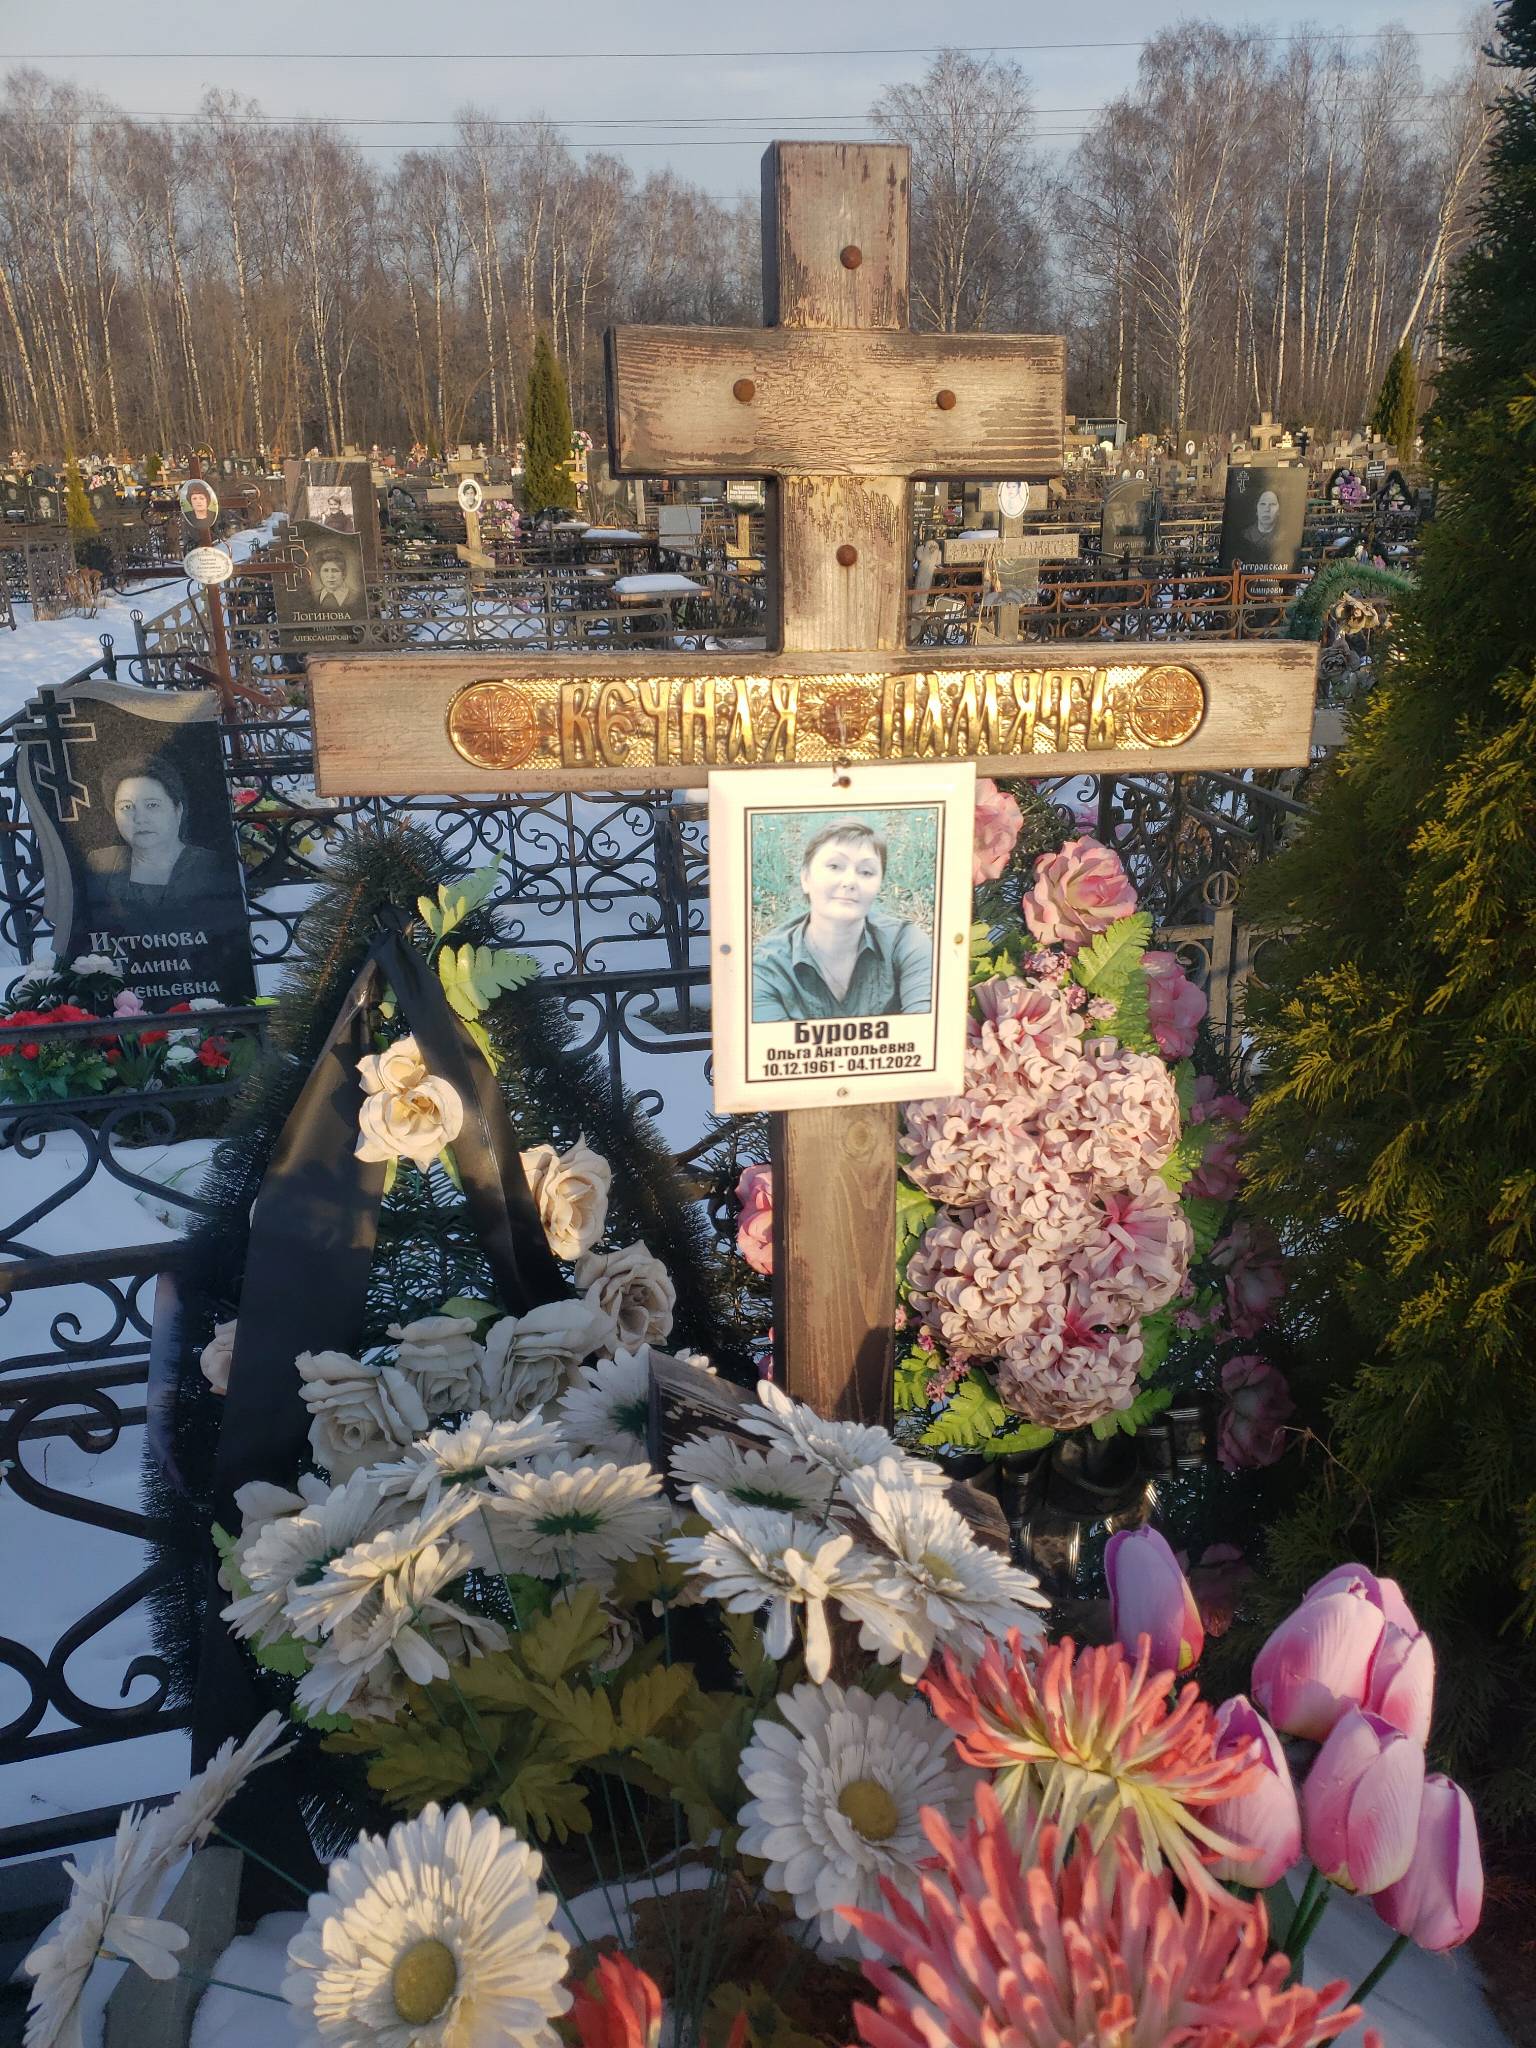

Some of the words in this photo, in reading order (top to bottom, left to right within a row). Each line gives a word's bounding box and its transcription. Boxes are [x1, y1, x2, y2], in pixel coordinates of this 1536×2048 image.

[293, 611, 352, 621] ЛОГИНОВА
[560, 677, 800, 768] ВЕЧНАЯ
[879, 669, 1116, 758] ПАМЯТЬ
[88, 931, 208, 957] ИХТОНОВА
[794, 1020, 889, 1045] Бурова
[767, 1048, 811, 1061] Ольга
[815, 1042, 915, 1058] Анатольевна
[762, 1061, 836, 1077] 10.12.1961
[847, 1054, 922, 1072] 04.11.2022
